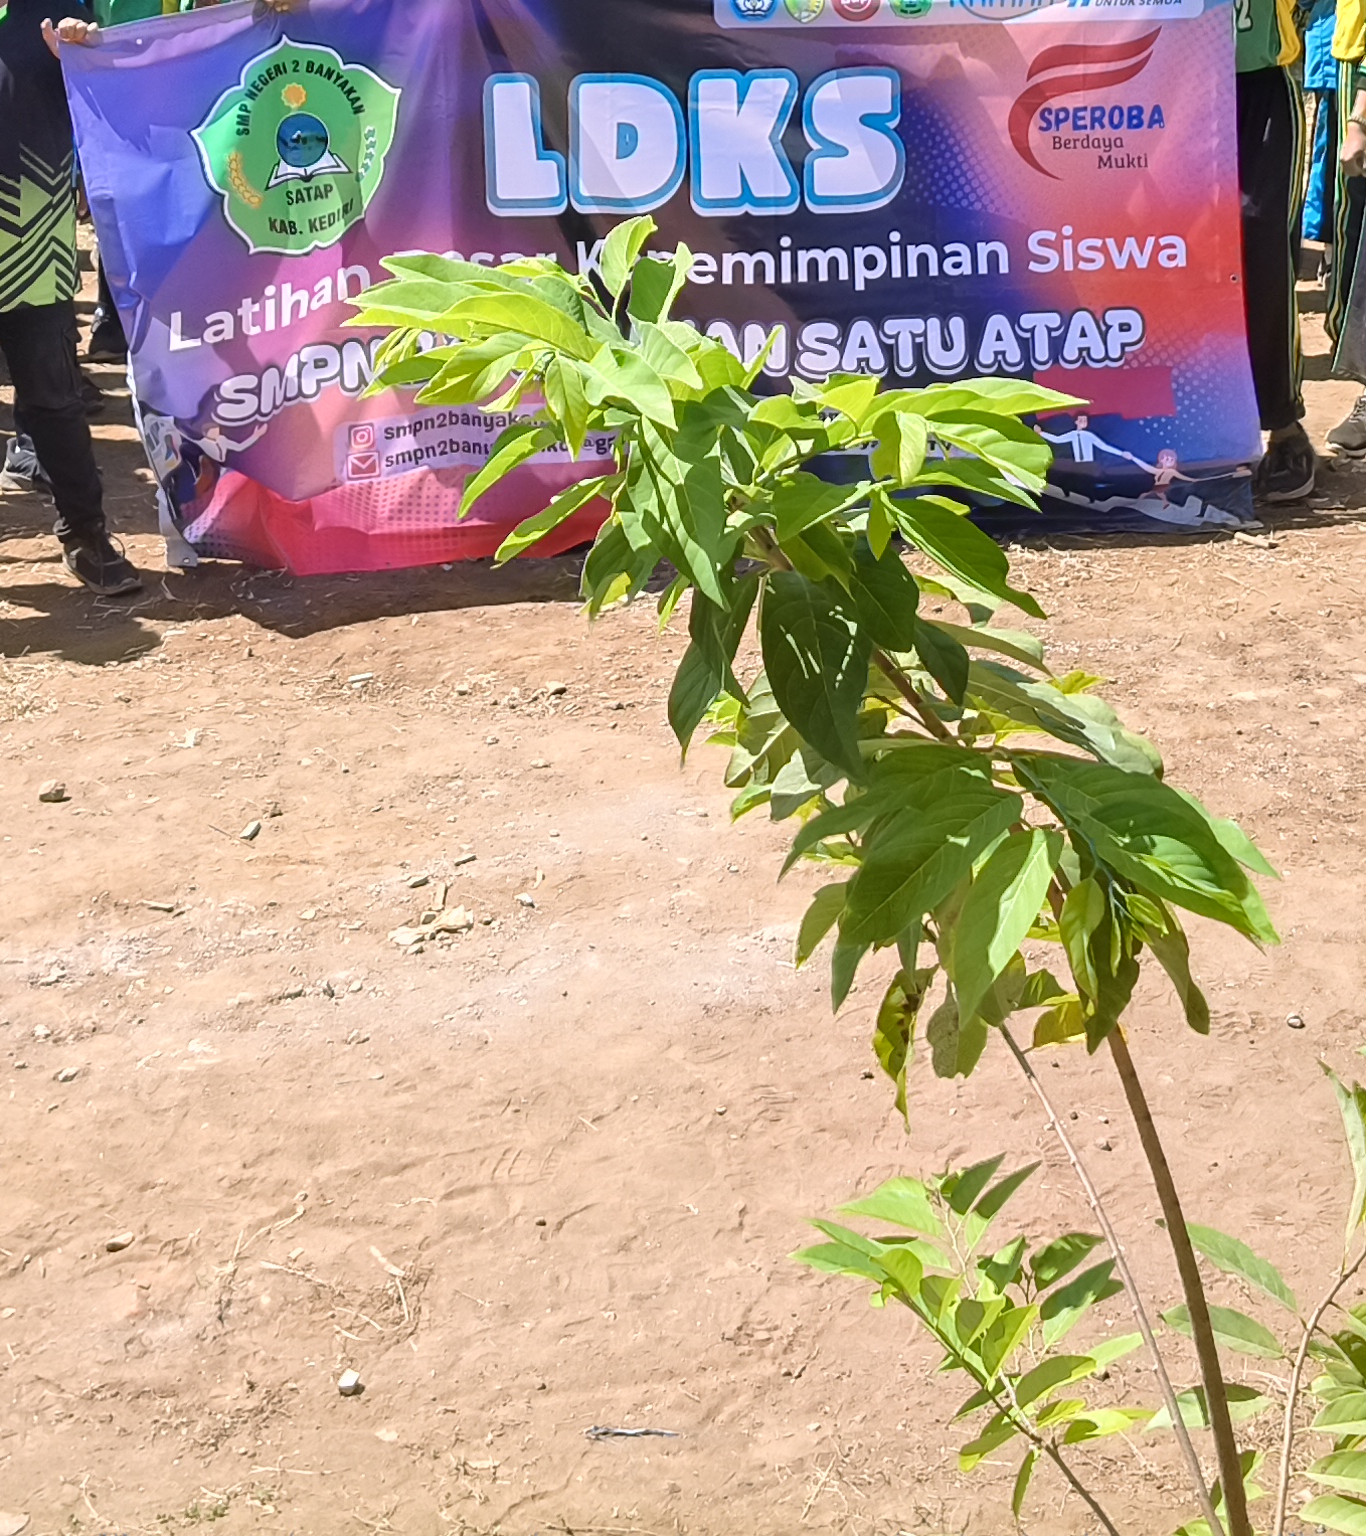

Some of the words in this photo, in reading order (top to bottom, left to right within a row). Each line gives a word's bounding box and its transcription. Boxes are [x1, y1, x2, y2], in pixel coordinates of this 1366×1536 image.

[236, 103, 252, 137] SMP
[245, 61, 288, 103] NEGERI
[291, 60, 300, 73] 2
[305, 60, 365, 115] BANYAKAN
[1038, 104, 1165, 132] SPEROBA
[483, 67, 905, 217] LDKS
[1052, 134, 1124, 153] Berdaya
[1096, 153, 1149, 170] Mukti
[286, 183, 333, 206] SATAP
[268, 216, 303, 236] KAB.
[169, 263, 370, 353] Latihan
[576, 230, 1009, 291] Kemimpinan
[1027, 225, 1187, 273] Siswa
[795, 314, 970, 379] SATU
[975, 307, 1147, 373] ATAP
